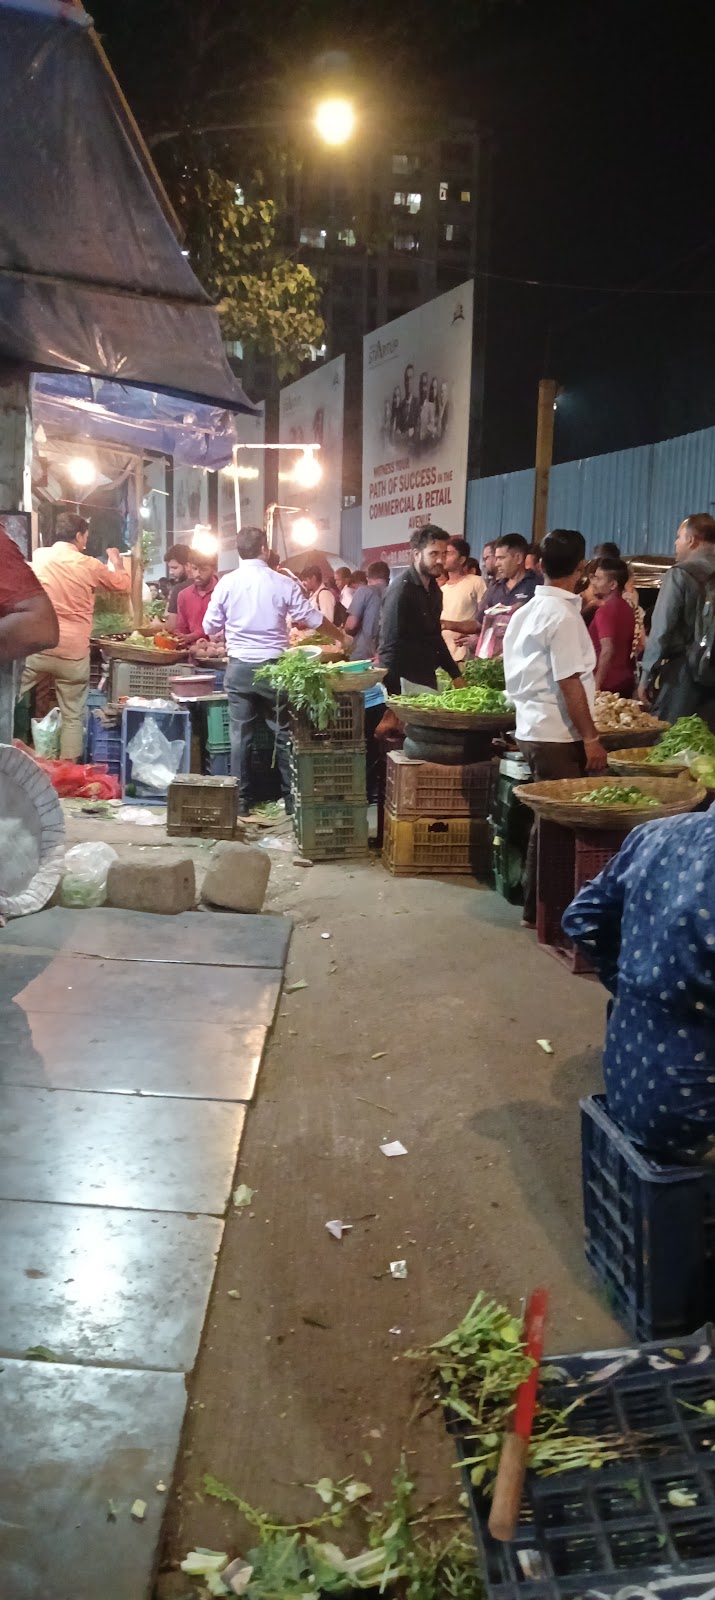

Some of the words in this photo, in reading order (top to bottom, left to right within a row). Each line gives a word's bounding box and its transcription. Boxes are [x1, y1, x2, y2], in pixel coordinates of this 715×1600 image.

[369, 480, 386, 499] PATH
[387, 477, 398, 495] OF
[399, 467, 437, 492] SUCCESS
[443, 470, 453, 482] THE
[369, 496, 415, 520] COMMERCIAL
[417, 493, 423, 510] &
[425, 487, 452, 508] RETAIL
[408, 513, 432, 529] AVENUE
